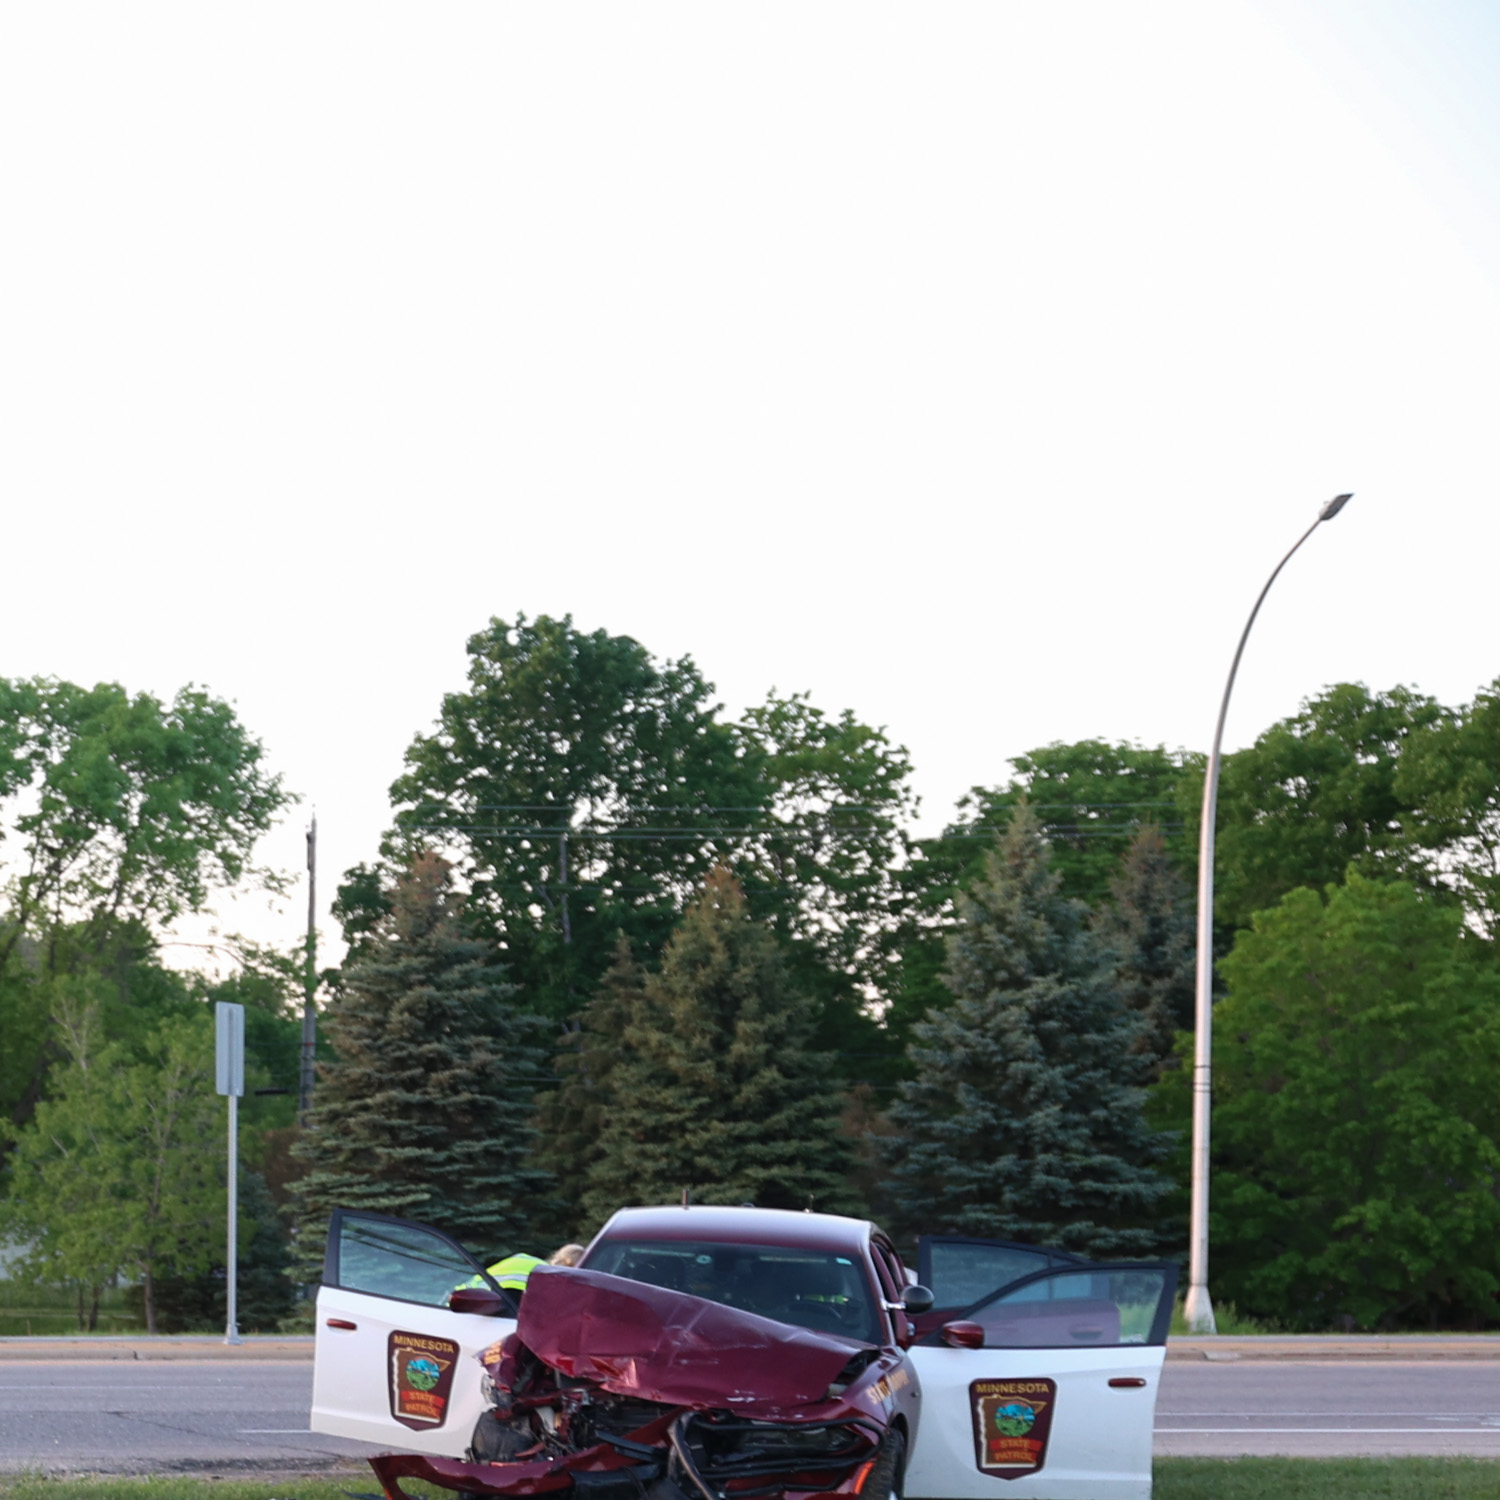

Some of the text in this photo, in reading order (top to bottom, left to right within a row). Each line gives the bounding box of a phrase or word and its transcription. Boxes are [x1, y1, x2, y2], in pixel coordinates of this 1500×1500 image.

[393, 1335, 454, 1353] MINNESOTA
[976, 1383, 1049, 1394] MINNESOTA
[409, 1390, 435, 1404] STATE
[405, 1403, 437, 1416] PATROL
[1000, 1439, 1030, 1449] STATE
[994, 1451, 1034, 1461] PATROL
